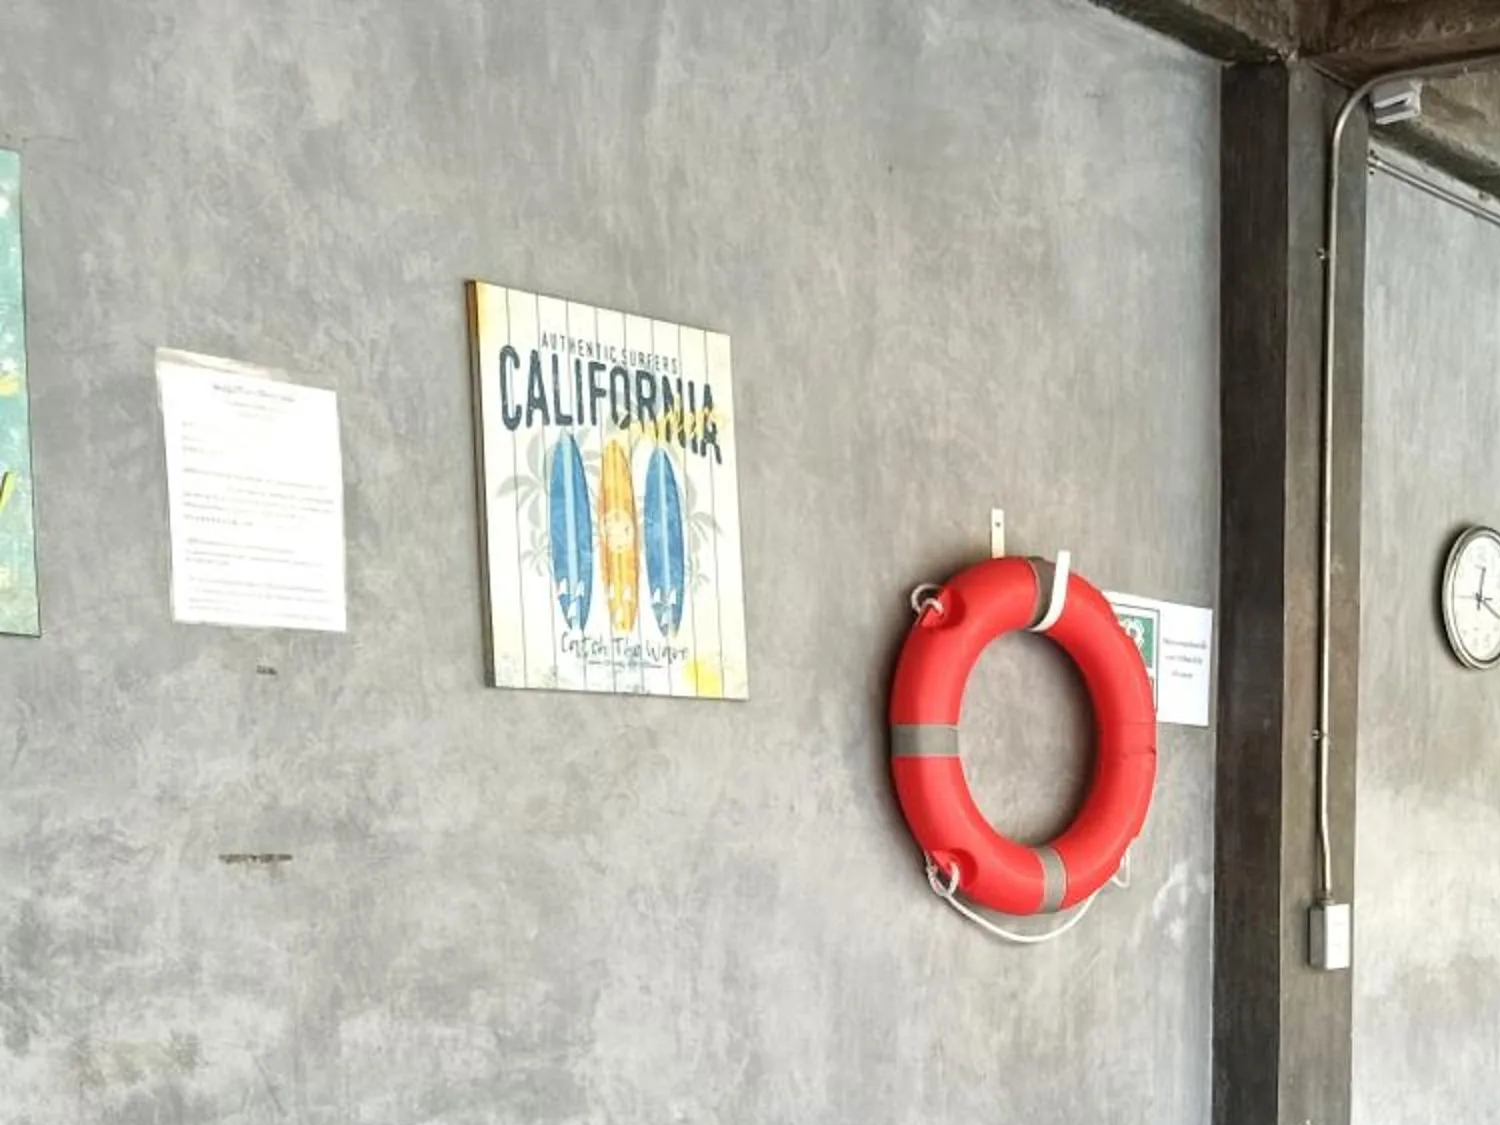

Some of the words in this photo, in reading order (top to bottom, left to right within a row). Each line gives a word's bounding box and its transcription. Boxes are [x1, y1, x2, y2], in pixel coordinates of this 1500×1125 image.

[541, 331, 619, 364] AUTHENTIC
[620, 348, 678, 375] SURFERS
[498, 343, 724, 466] CALIFORNIA
